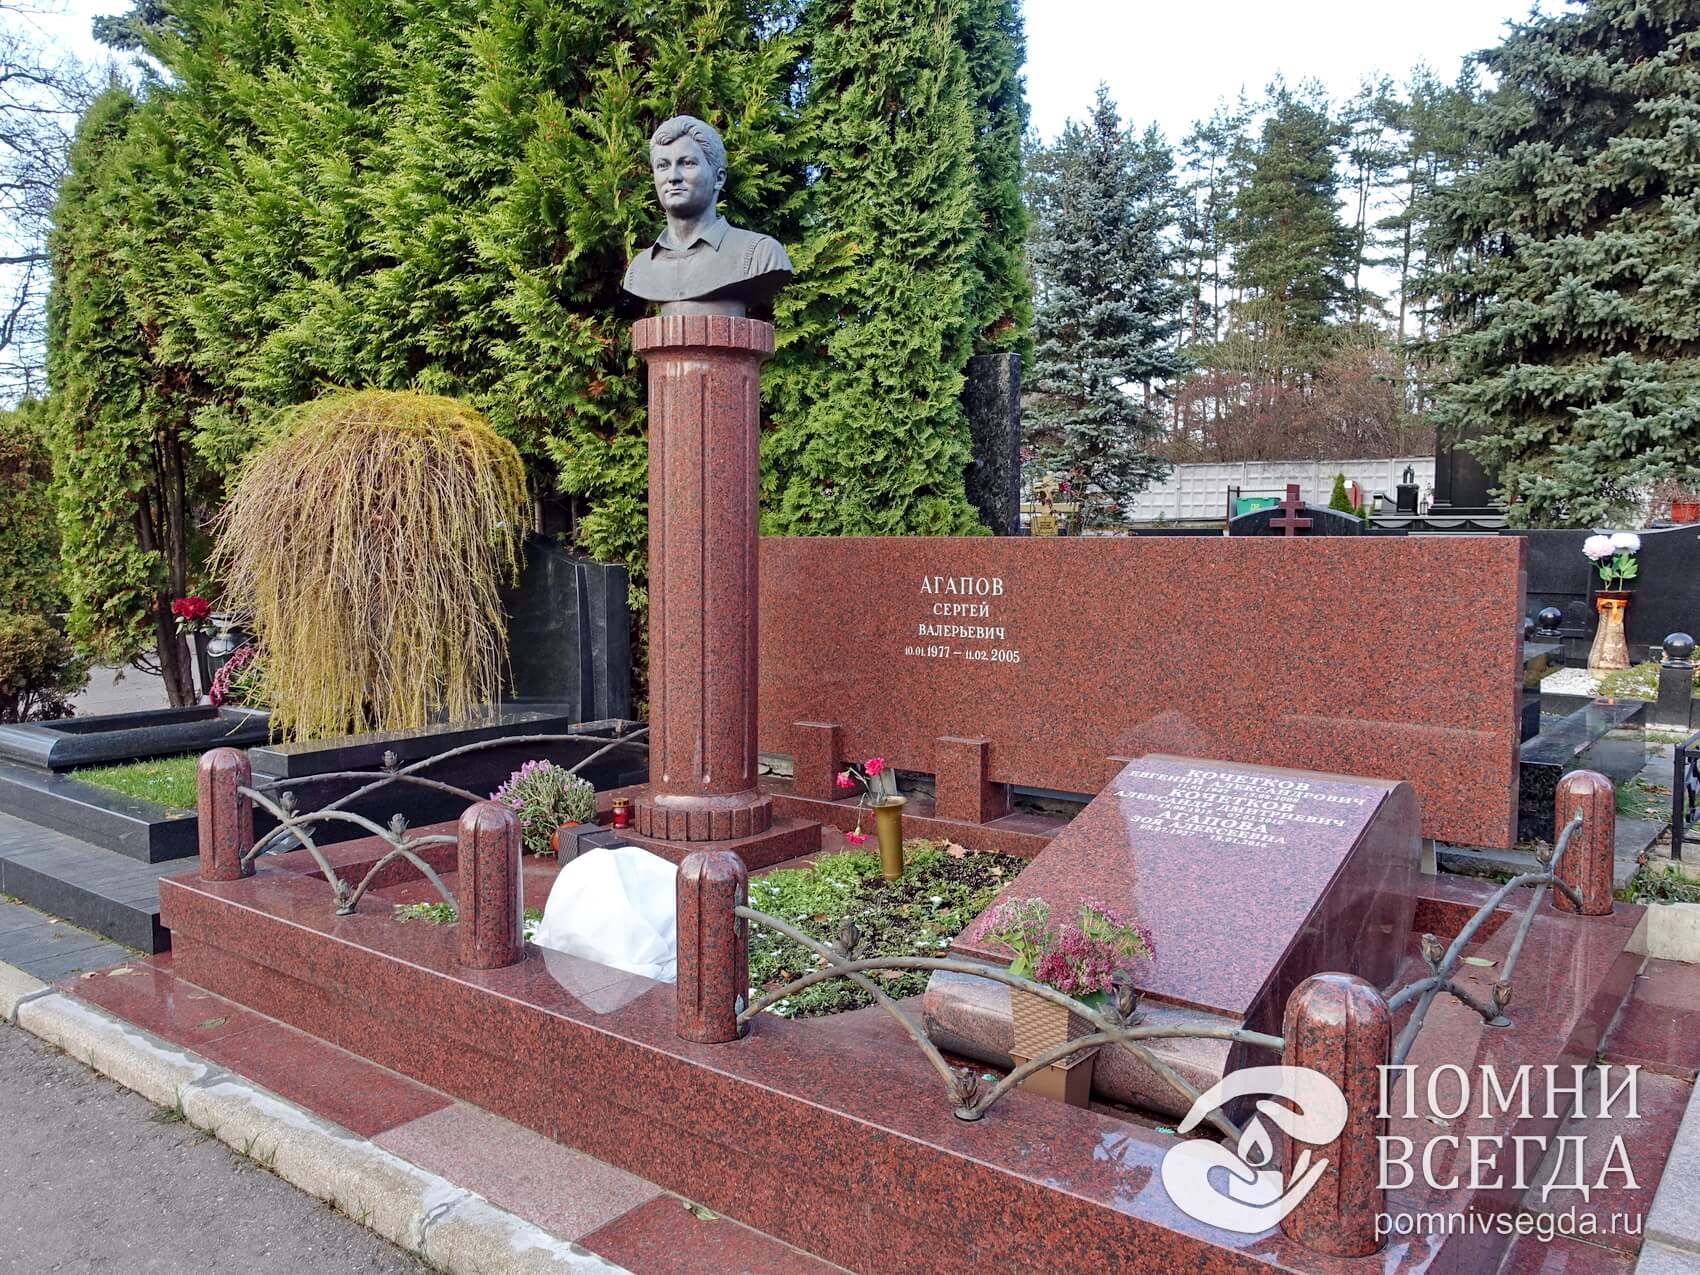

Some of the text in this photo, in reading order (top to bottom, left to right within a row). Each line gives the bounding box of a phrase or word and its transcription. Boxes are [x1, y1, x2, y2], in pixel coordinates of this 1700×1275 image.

[920, 575, 1004, 596] АГАПОВ
[933, 601, 990, 617] СЕРГЕЙ
[918, 624, 1006, 640] ВАЛЕРЬЕВИЧ
[1129, 770, 1366, 806] ЕВГЕНИЙ АЛЕКСАНДРОВИЧ
[1186, 769, 1311, 791] КОЧЕТКОВ
[1113, 790, 1347, 827] АЛЕКСАНДР ДМИТРИЕВИЧ
[1168, 788, 1295, 813] КОЧЕТКОВ
[1130, 815, 1287, 844] ЗОЯ АЛЕКСЕЕВНА
[1155, 810, 1269, 834] АГАПОВА
